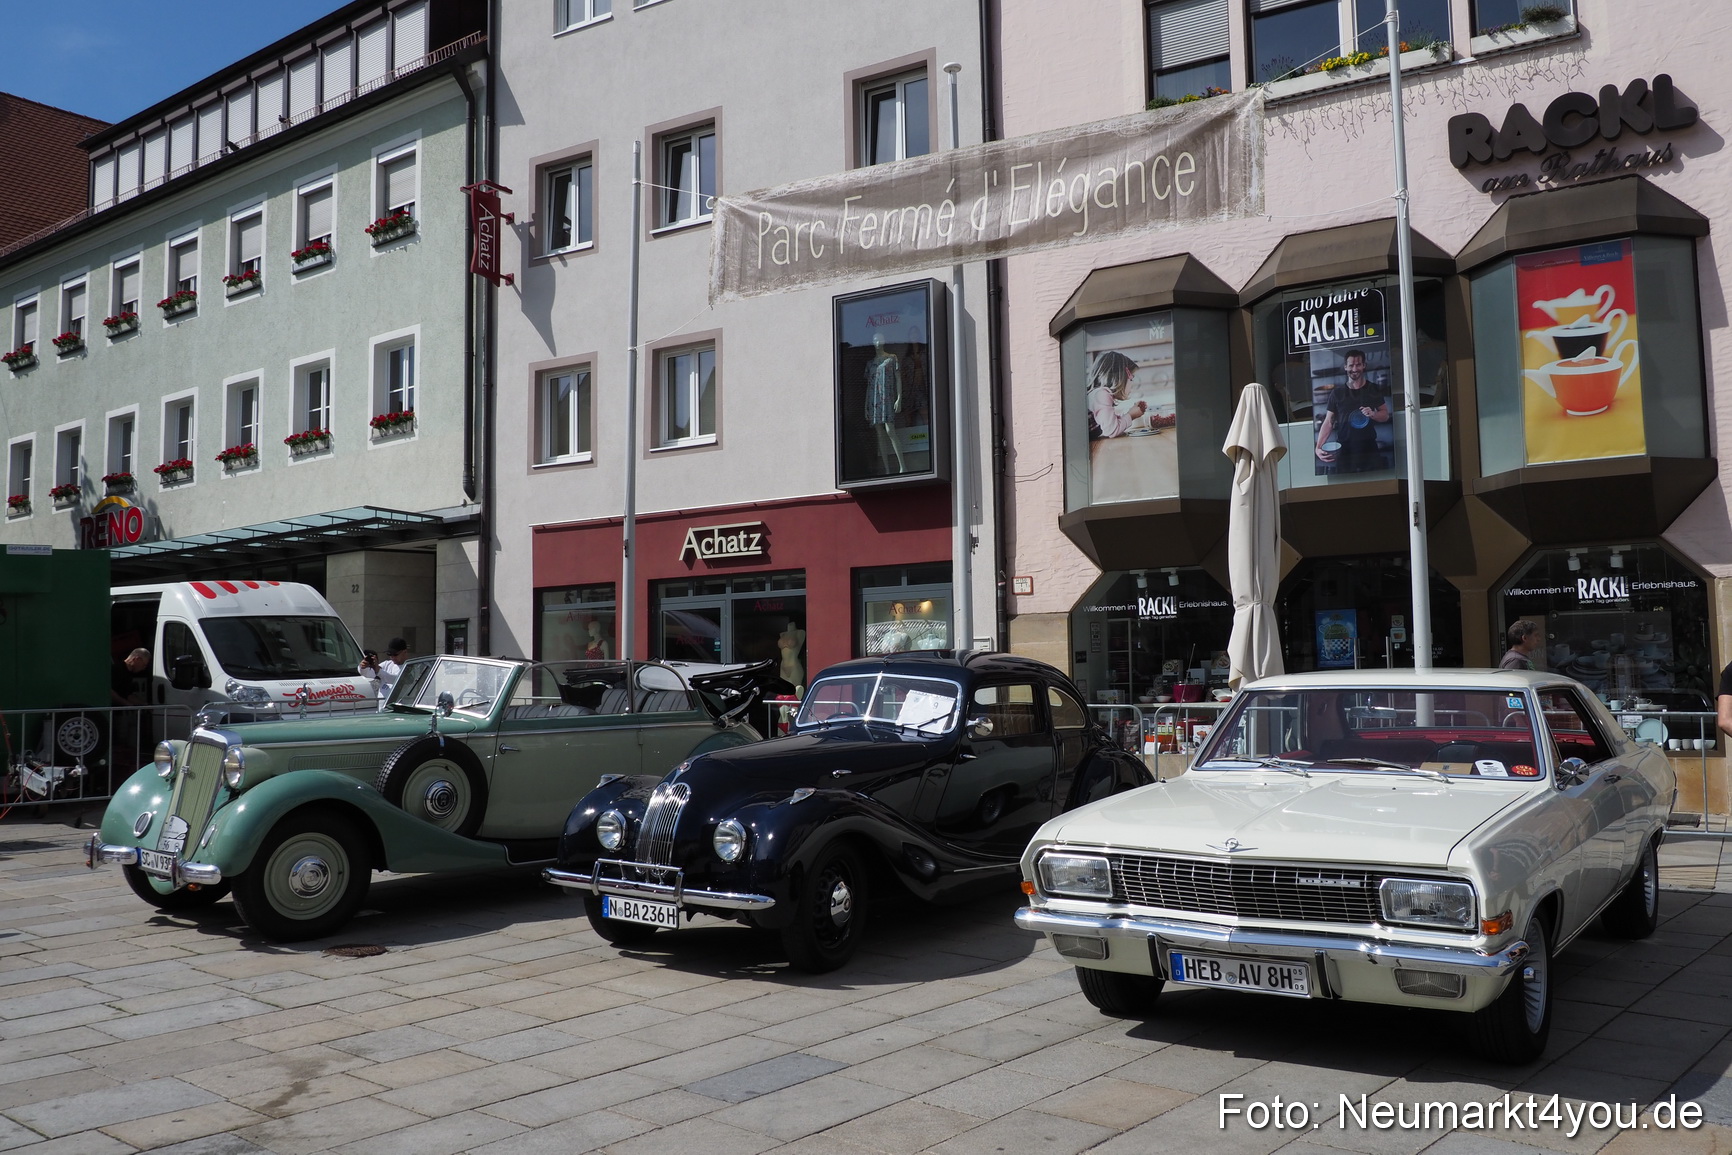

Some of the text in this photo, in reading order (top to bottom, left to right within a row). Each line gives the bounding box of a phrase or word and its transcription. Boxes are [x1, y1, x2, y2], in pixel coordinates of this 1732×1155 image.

[1447, 73, 1698, 169] RACKL
[1481, 142, 1674, 193] am Rathaus
[478, 203, 496, 270] Achatz
[758, 211, 825, 269] Parc
[840, 178, 956, 255] Fermé
[1299, 287, 1369, 313] 100 Jahre
[1293, 308, 1359, 346] RACKL
[80, 506, 144, 549] RENO
[679, 521, 762, 560] Achatz
[351, 584, 360, 593] 22
[1504, 586, 1561, 596] Willkommen
[1563, 586, 1575, 594] im
[1578, 576, 1629, 599] RACKL
[1631, 580, 1699, 590] Erlebnishaus.
[754, 598, 783, 612] Achatz
[889, 602, 922, 615] Achatz
[1138, 596, 1177, 616] RACKL
[1179, 600, 1229, 608] Erlebnishaus.
[142, 852, 150, 865] SC
[609, 899, 617, 916] N
[1184, 958, 1222, 981] HEB
[1238, 963, 1261, 985] AV
[1267, 966, 1293, 989] 8H
